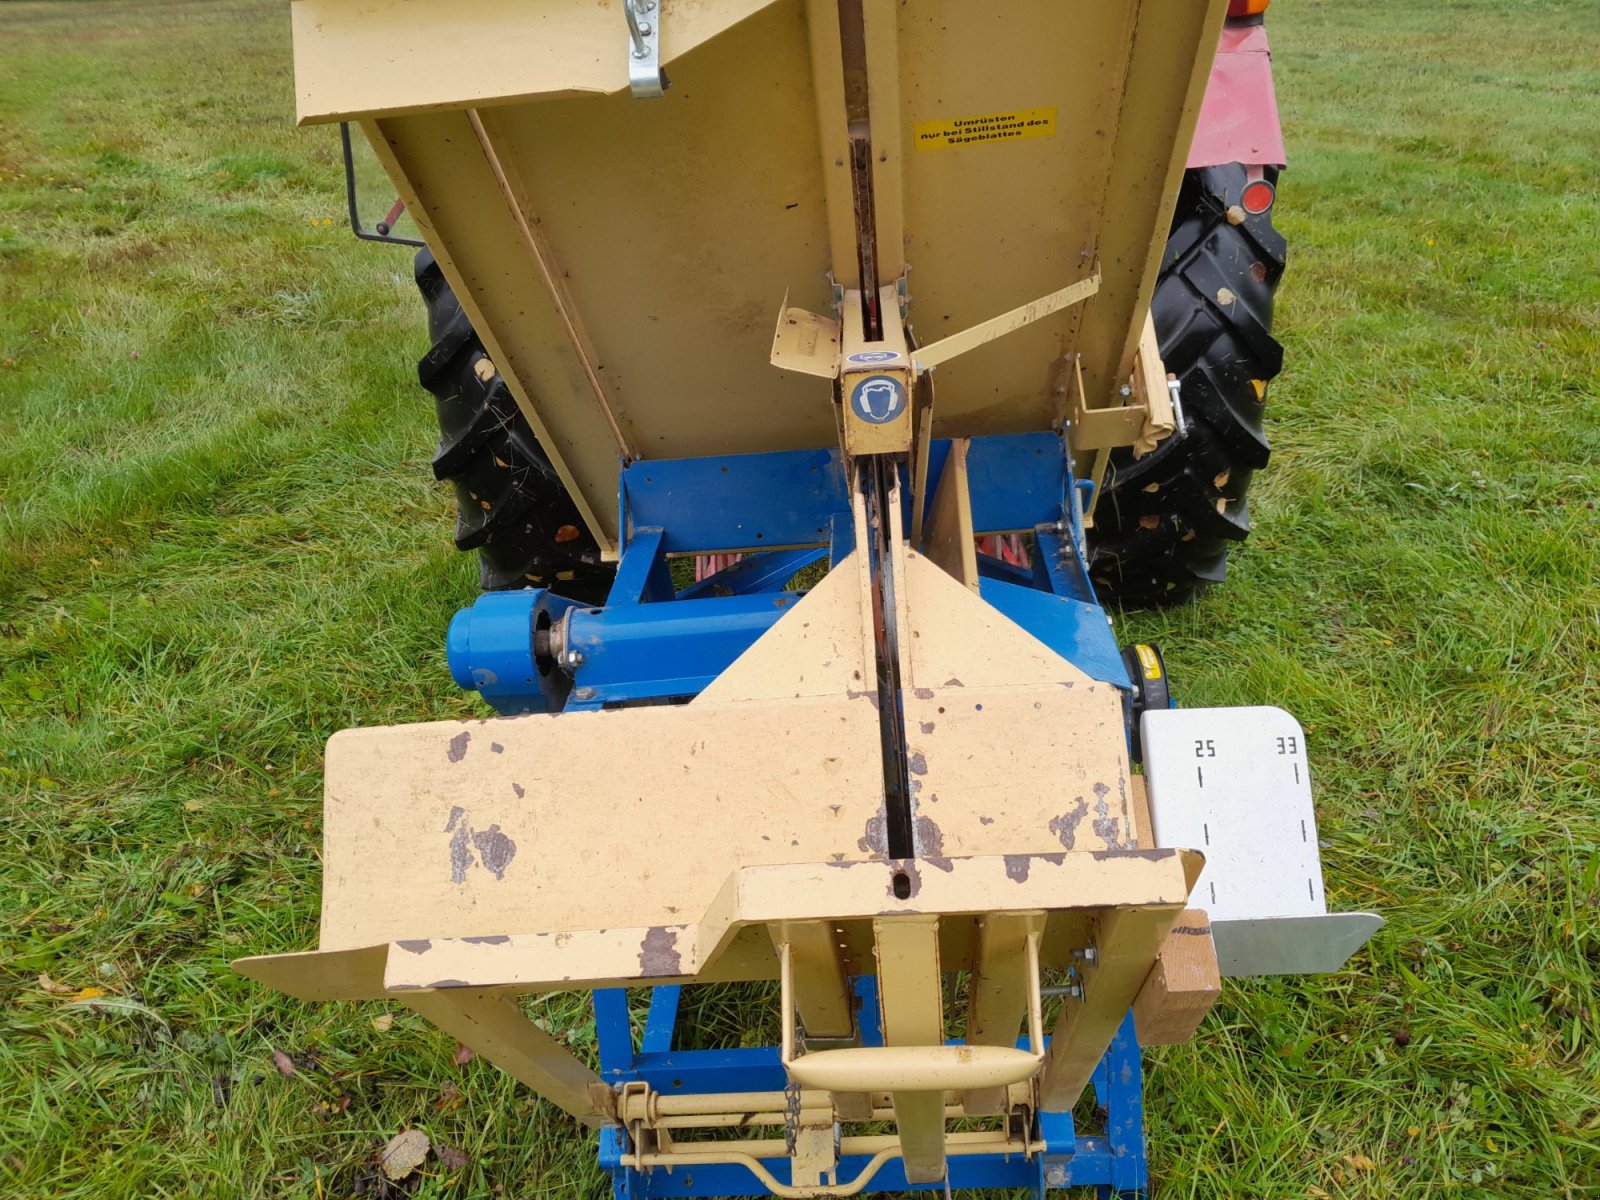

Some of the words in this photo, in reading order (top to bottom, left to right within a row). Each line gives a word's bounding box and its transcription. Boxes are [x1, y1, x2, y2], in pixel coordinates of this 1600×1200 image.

[920, 132, 941, 140] nur
[943, 129, 962, 137] bei
[964, 121, 1025, 134] Stillstand
[1026, 119, 1049, 127] des
[953, 114, 1016, 127] Umrüsten
[947, 130, 1022, 144] Sägeblattes
[1195, 740, 1216, 758] 25
[1276, 736, 1297, 755] 33
